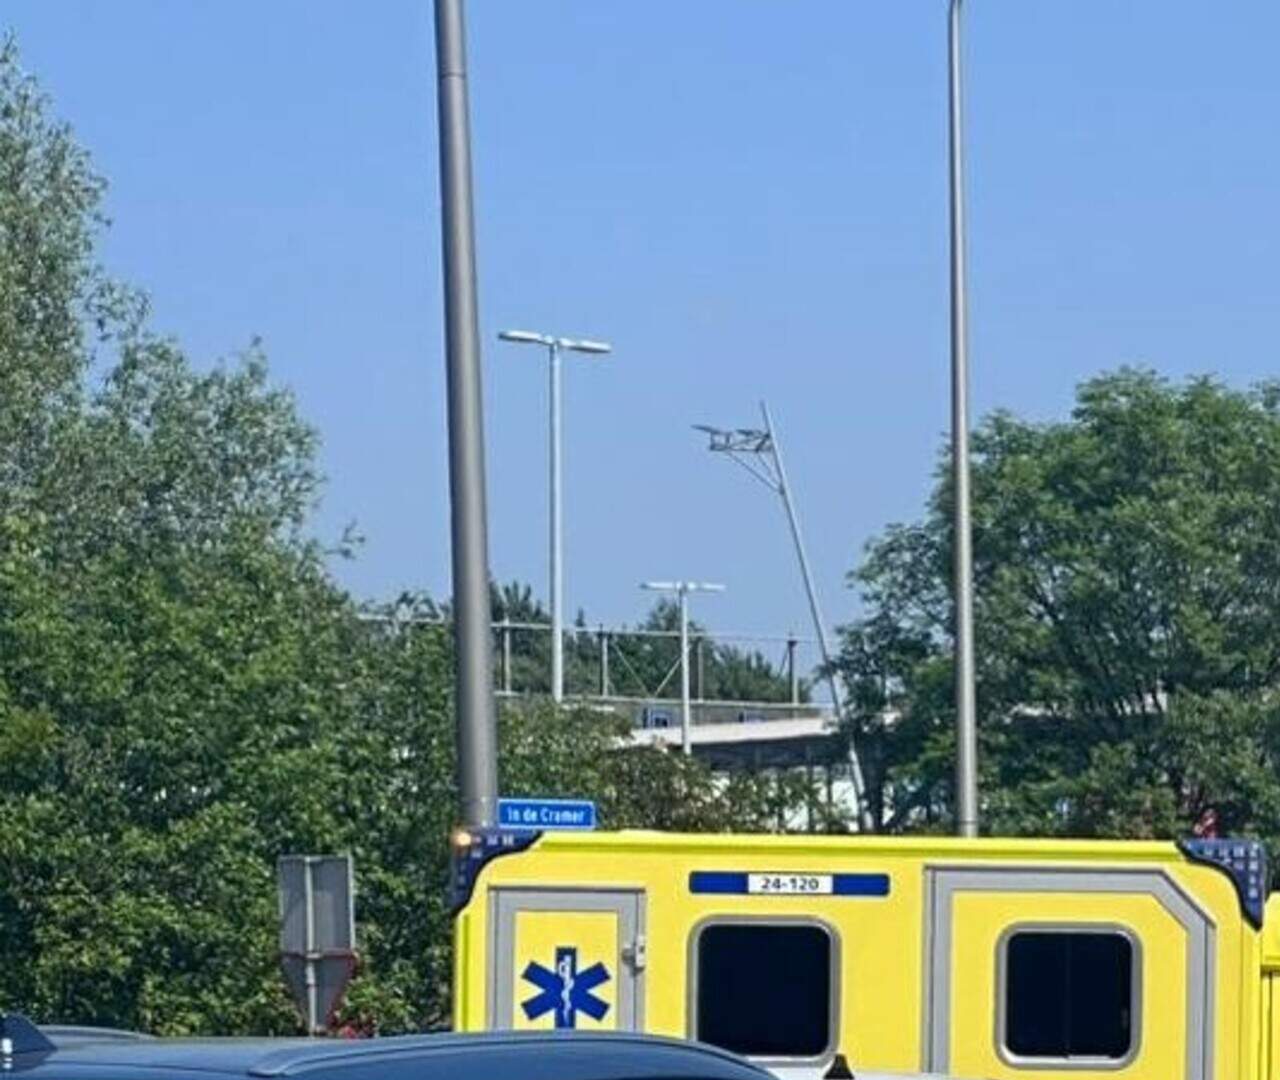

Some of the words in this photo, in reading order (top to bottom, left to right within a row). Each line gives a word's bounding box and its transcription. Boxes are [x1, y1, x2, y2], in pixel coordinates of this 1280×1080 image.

[523, 806, 538, 822] de
[540, 806, 584, 823] Cramer
[761, 877, 819, 890] 24-120
